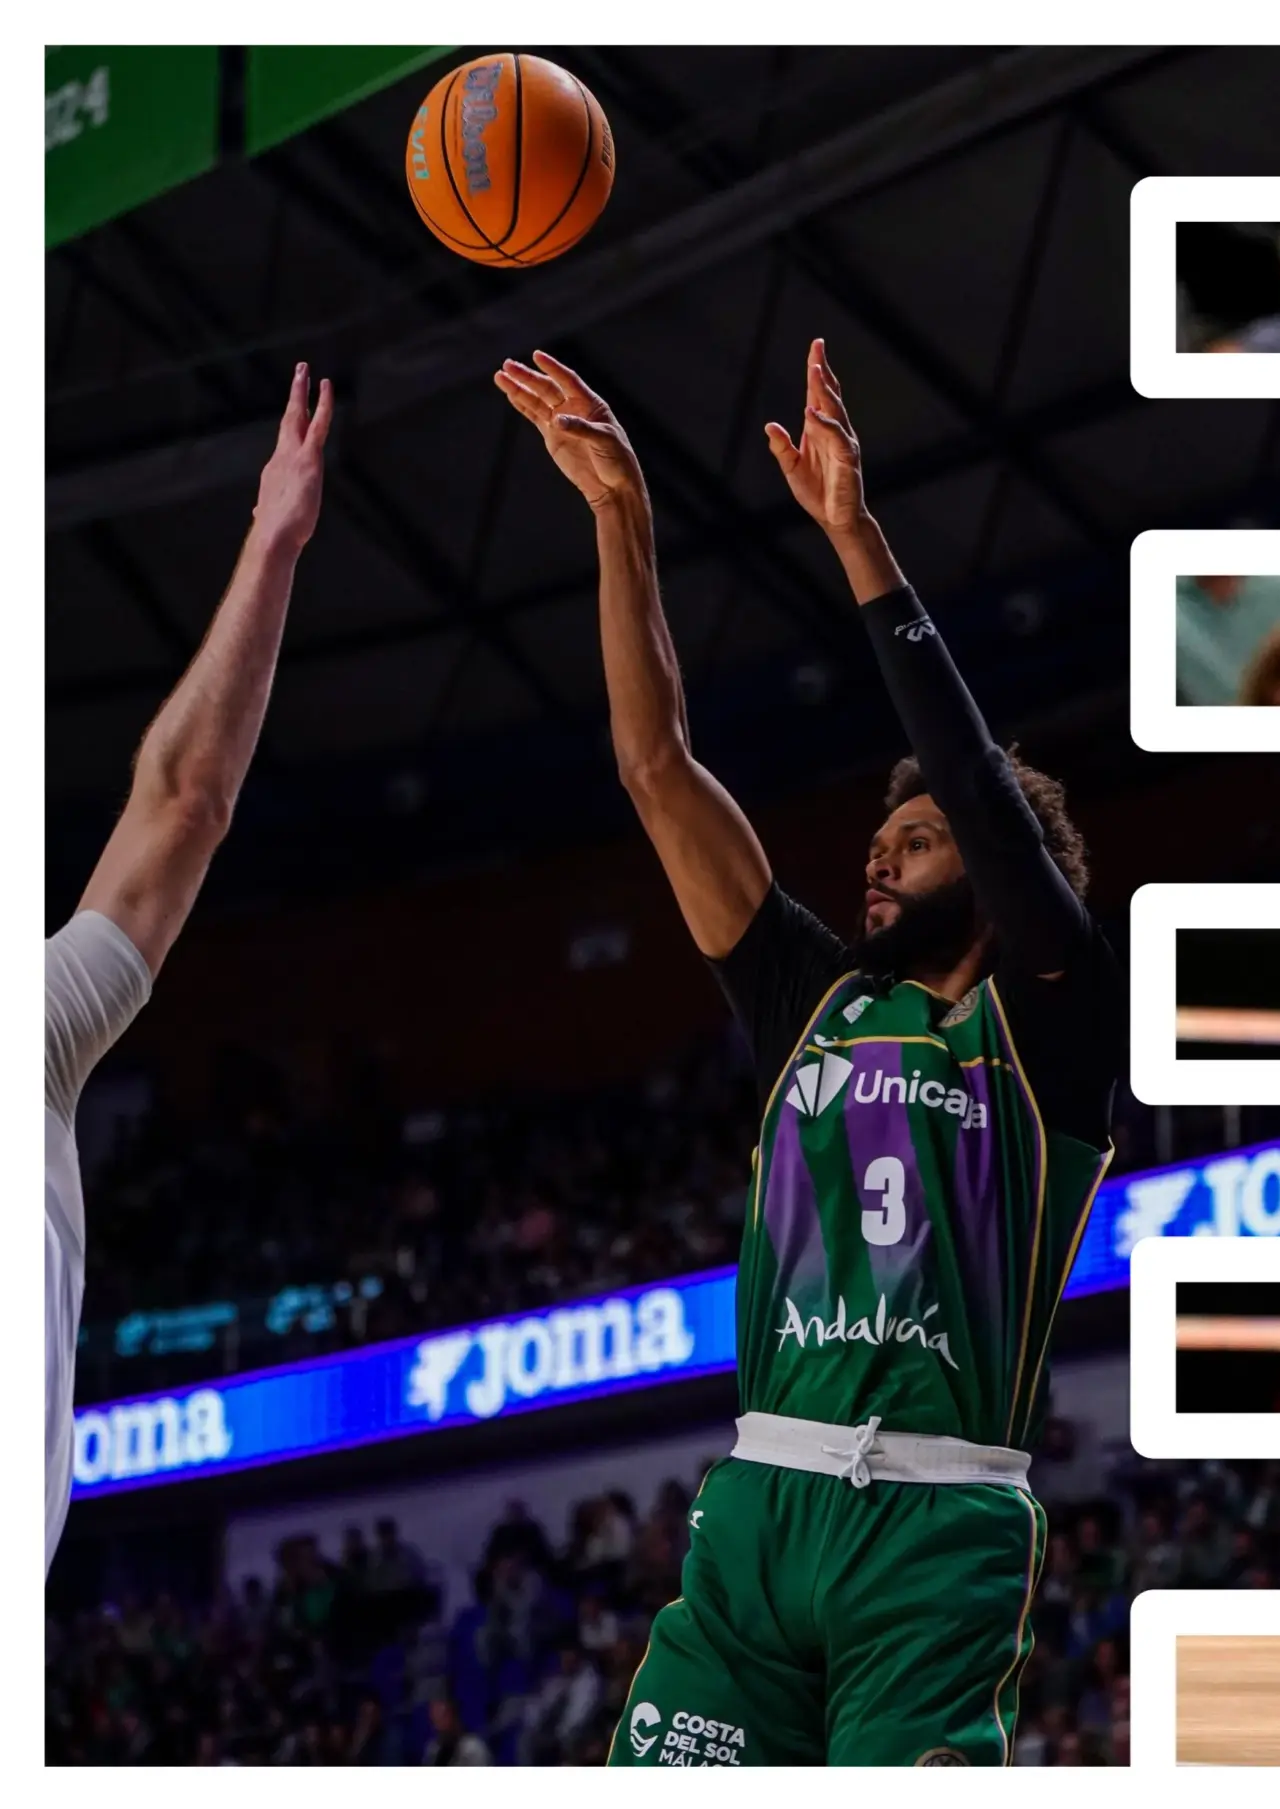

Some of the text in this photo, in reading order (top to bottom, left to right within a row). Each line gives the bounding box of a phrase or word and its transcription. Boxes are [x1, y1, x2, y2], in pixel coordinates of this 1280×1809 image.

[853, 1069, 988, 1130] Unicaja
[861, 1156, 907, 1247] 3
[73, 1389, 233, 1485] oma
[664, 1730, 741, 1766] DEL SOL
[672, 1711, 746, 1748] COSTA
